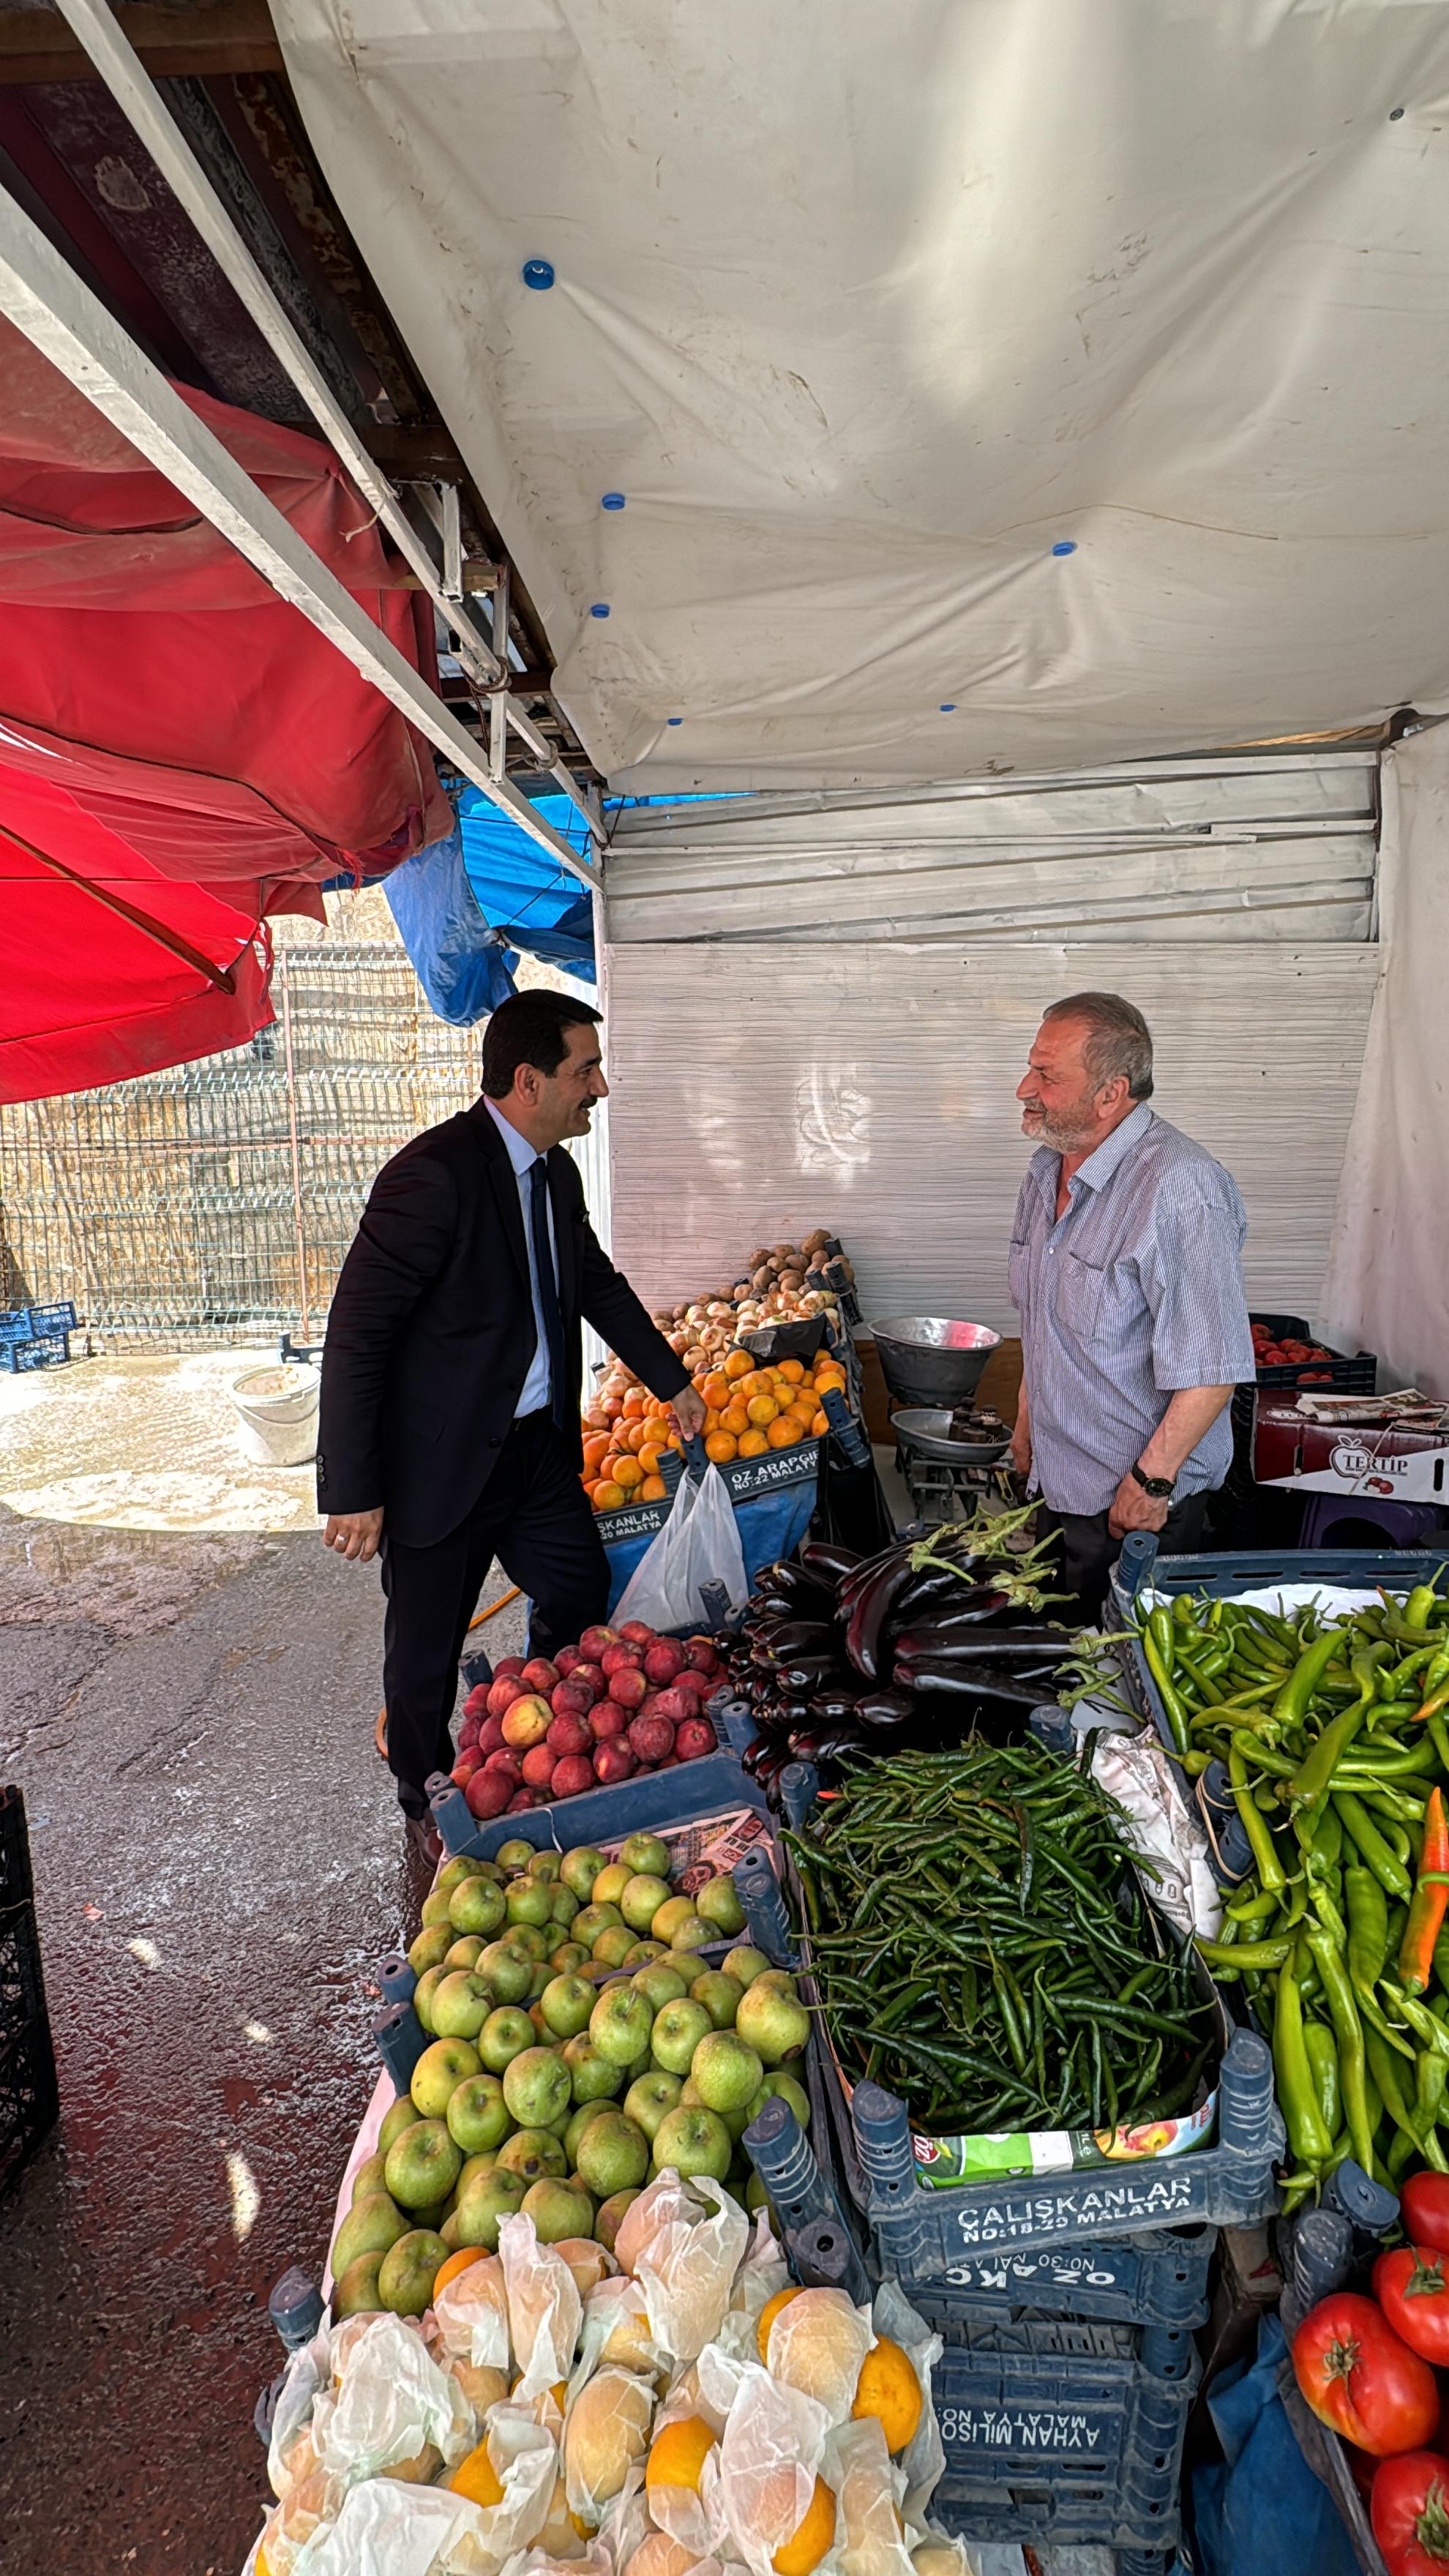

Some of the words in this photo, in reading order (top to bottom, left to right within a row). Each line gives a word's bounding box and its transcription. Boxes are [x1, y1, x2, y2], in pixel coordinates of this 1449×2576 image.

[615, 1521, 662, 1536] MALATYA
[957, 2177, 1191, 2230] ÇALIŞKANLAR
[1077, 2197, 1190, 2224] MALATYA
[983, 2411, 1087, 2429] MALATYA
[1022, 2426, 1100, 2447] AYHAN
